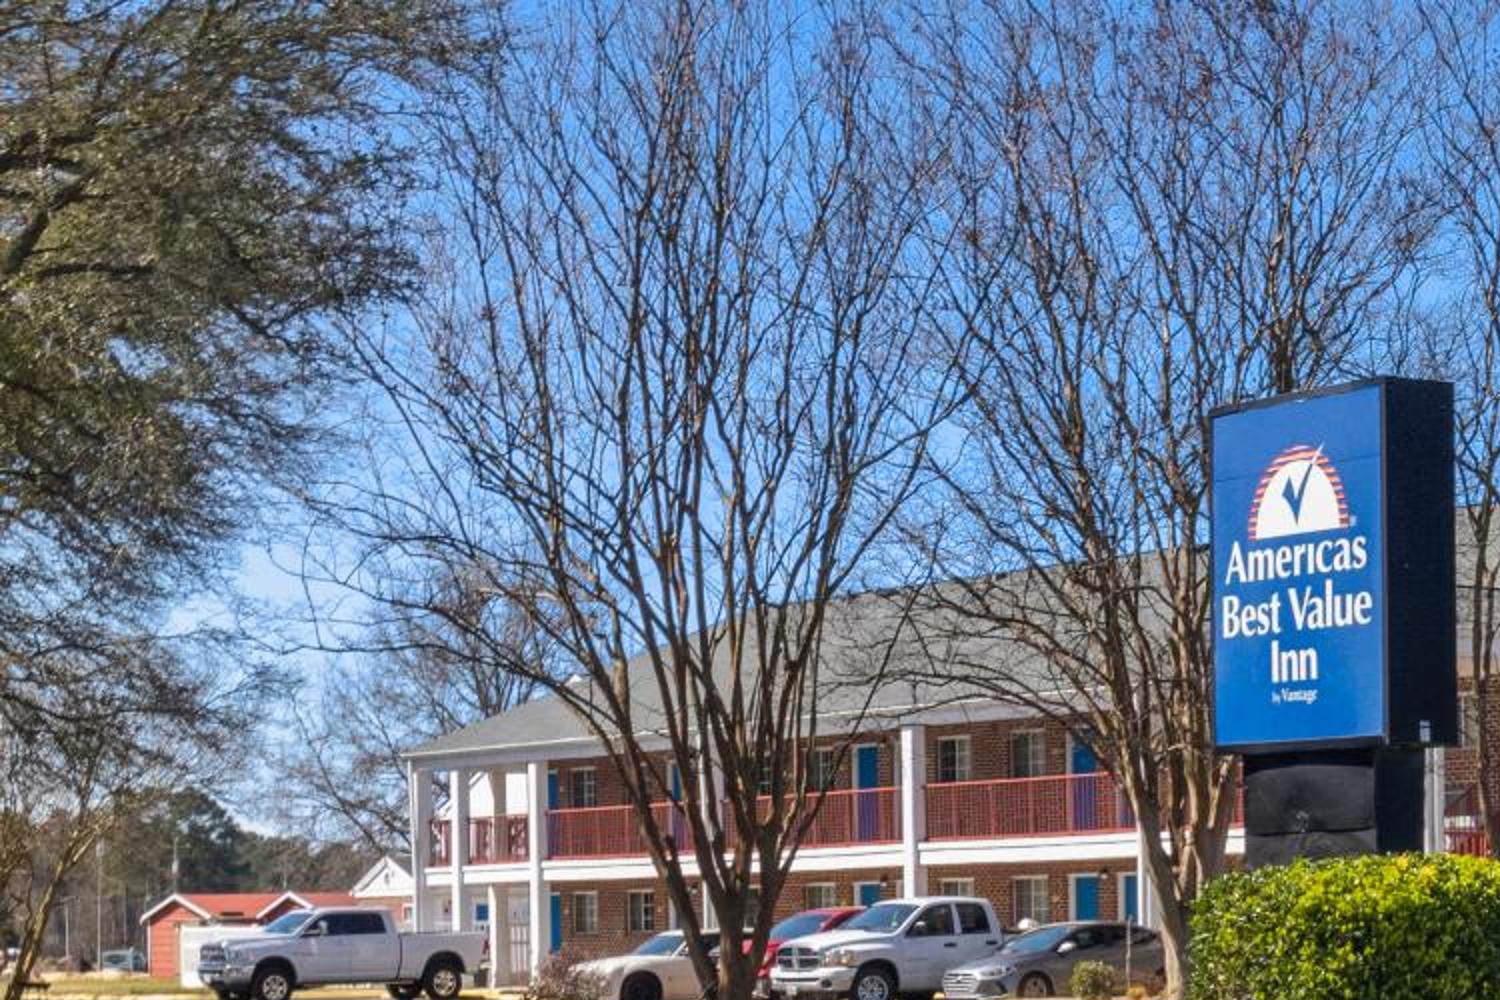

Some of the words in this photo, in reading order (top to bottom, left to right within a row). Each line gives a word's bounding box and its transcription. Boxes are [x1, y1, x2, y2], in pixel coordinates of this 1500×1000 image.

[1225, 536, 1367, 584] Americas
[1222, 592, 1281, 638] Best
[1288, 579, 1372, 631] Value
[1270, 639, 1319, 684] Inn
